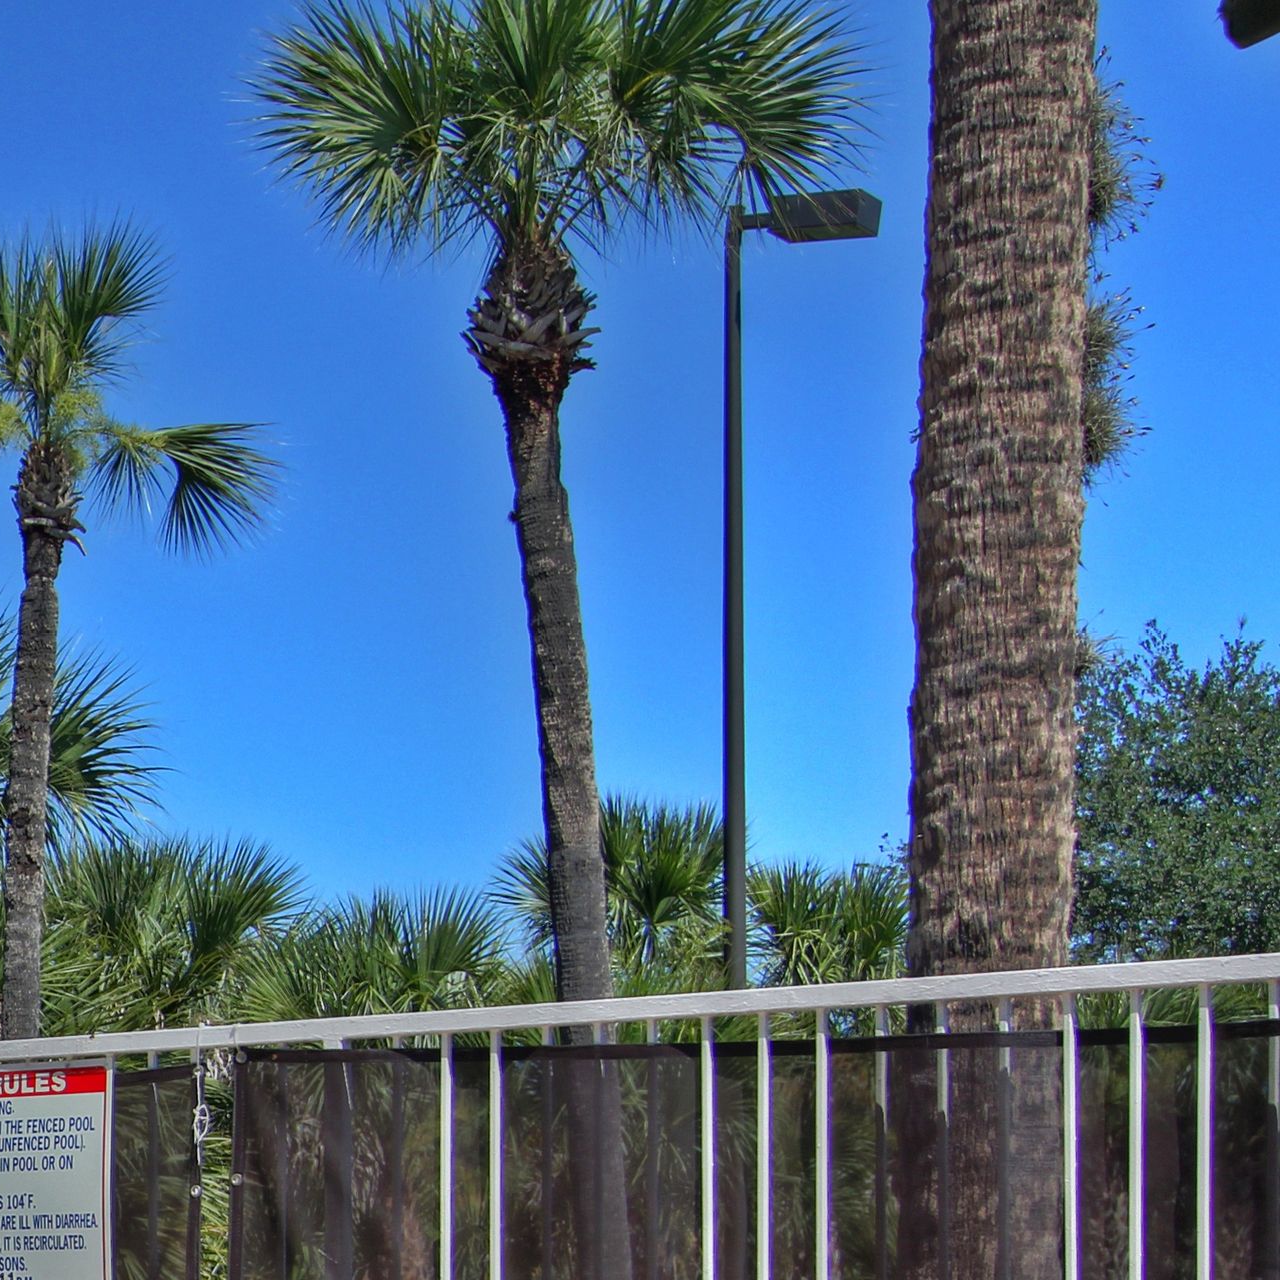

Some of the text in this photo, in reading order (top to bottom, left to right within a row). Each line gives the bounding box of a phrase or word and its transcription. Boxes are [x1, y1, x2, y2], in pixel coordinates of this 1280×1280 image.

[5, 1119, 22, 1134] THE
[27, 1118, 64, 1133] FENCED
[69, 1116, 95, 1131] POOL
[54, 1135, 85, 1152] POOL).
[0, 1158, 10, 1172] IN
[13, 1156, 38, 1171] POOL
[42, 1156, 55, 1170] OR
[59, 1155, 73, 1170] ON
[1, 1215, 16, 1230] ARE
[19, 1215, 31, 1230] ILL
[33, 1214, 53, 1229] WITH
[56, 1213, 98, 1228] DIARRHEA.
[4, 1236, 10, 1250] IT
[14, 1236, 21, 1250] IS
[24, 1235, 86, 1250] RECIRCULATED.
